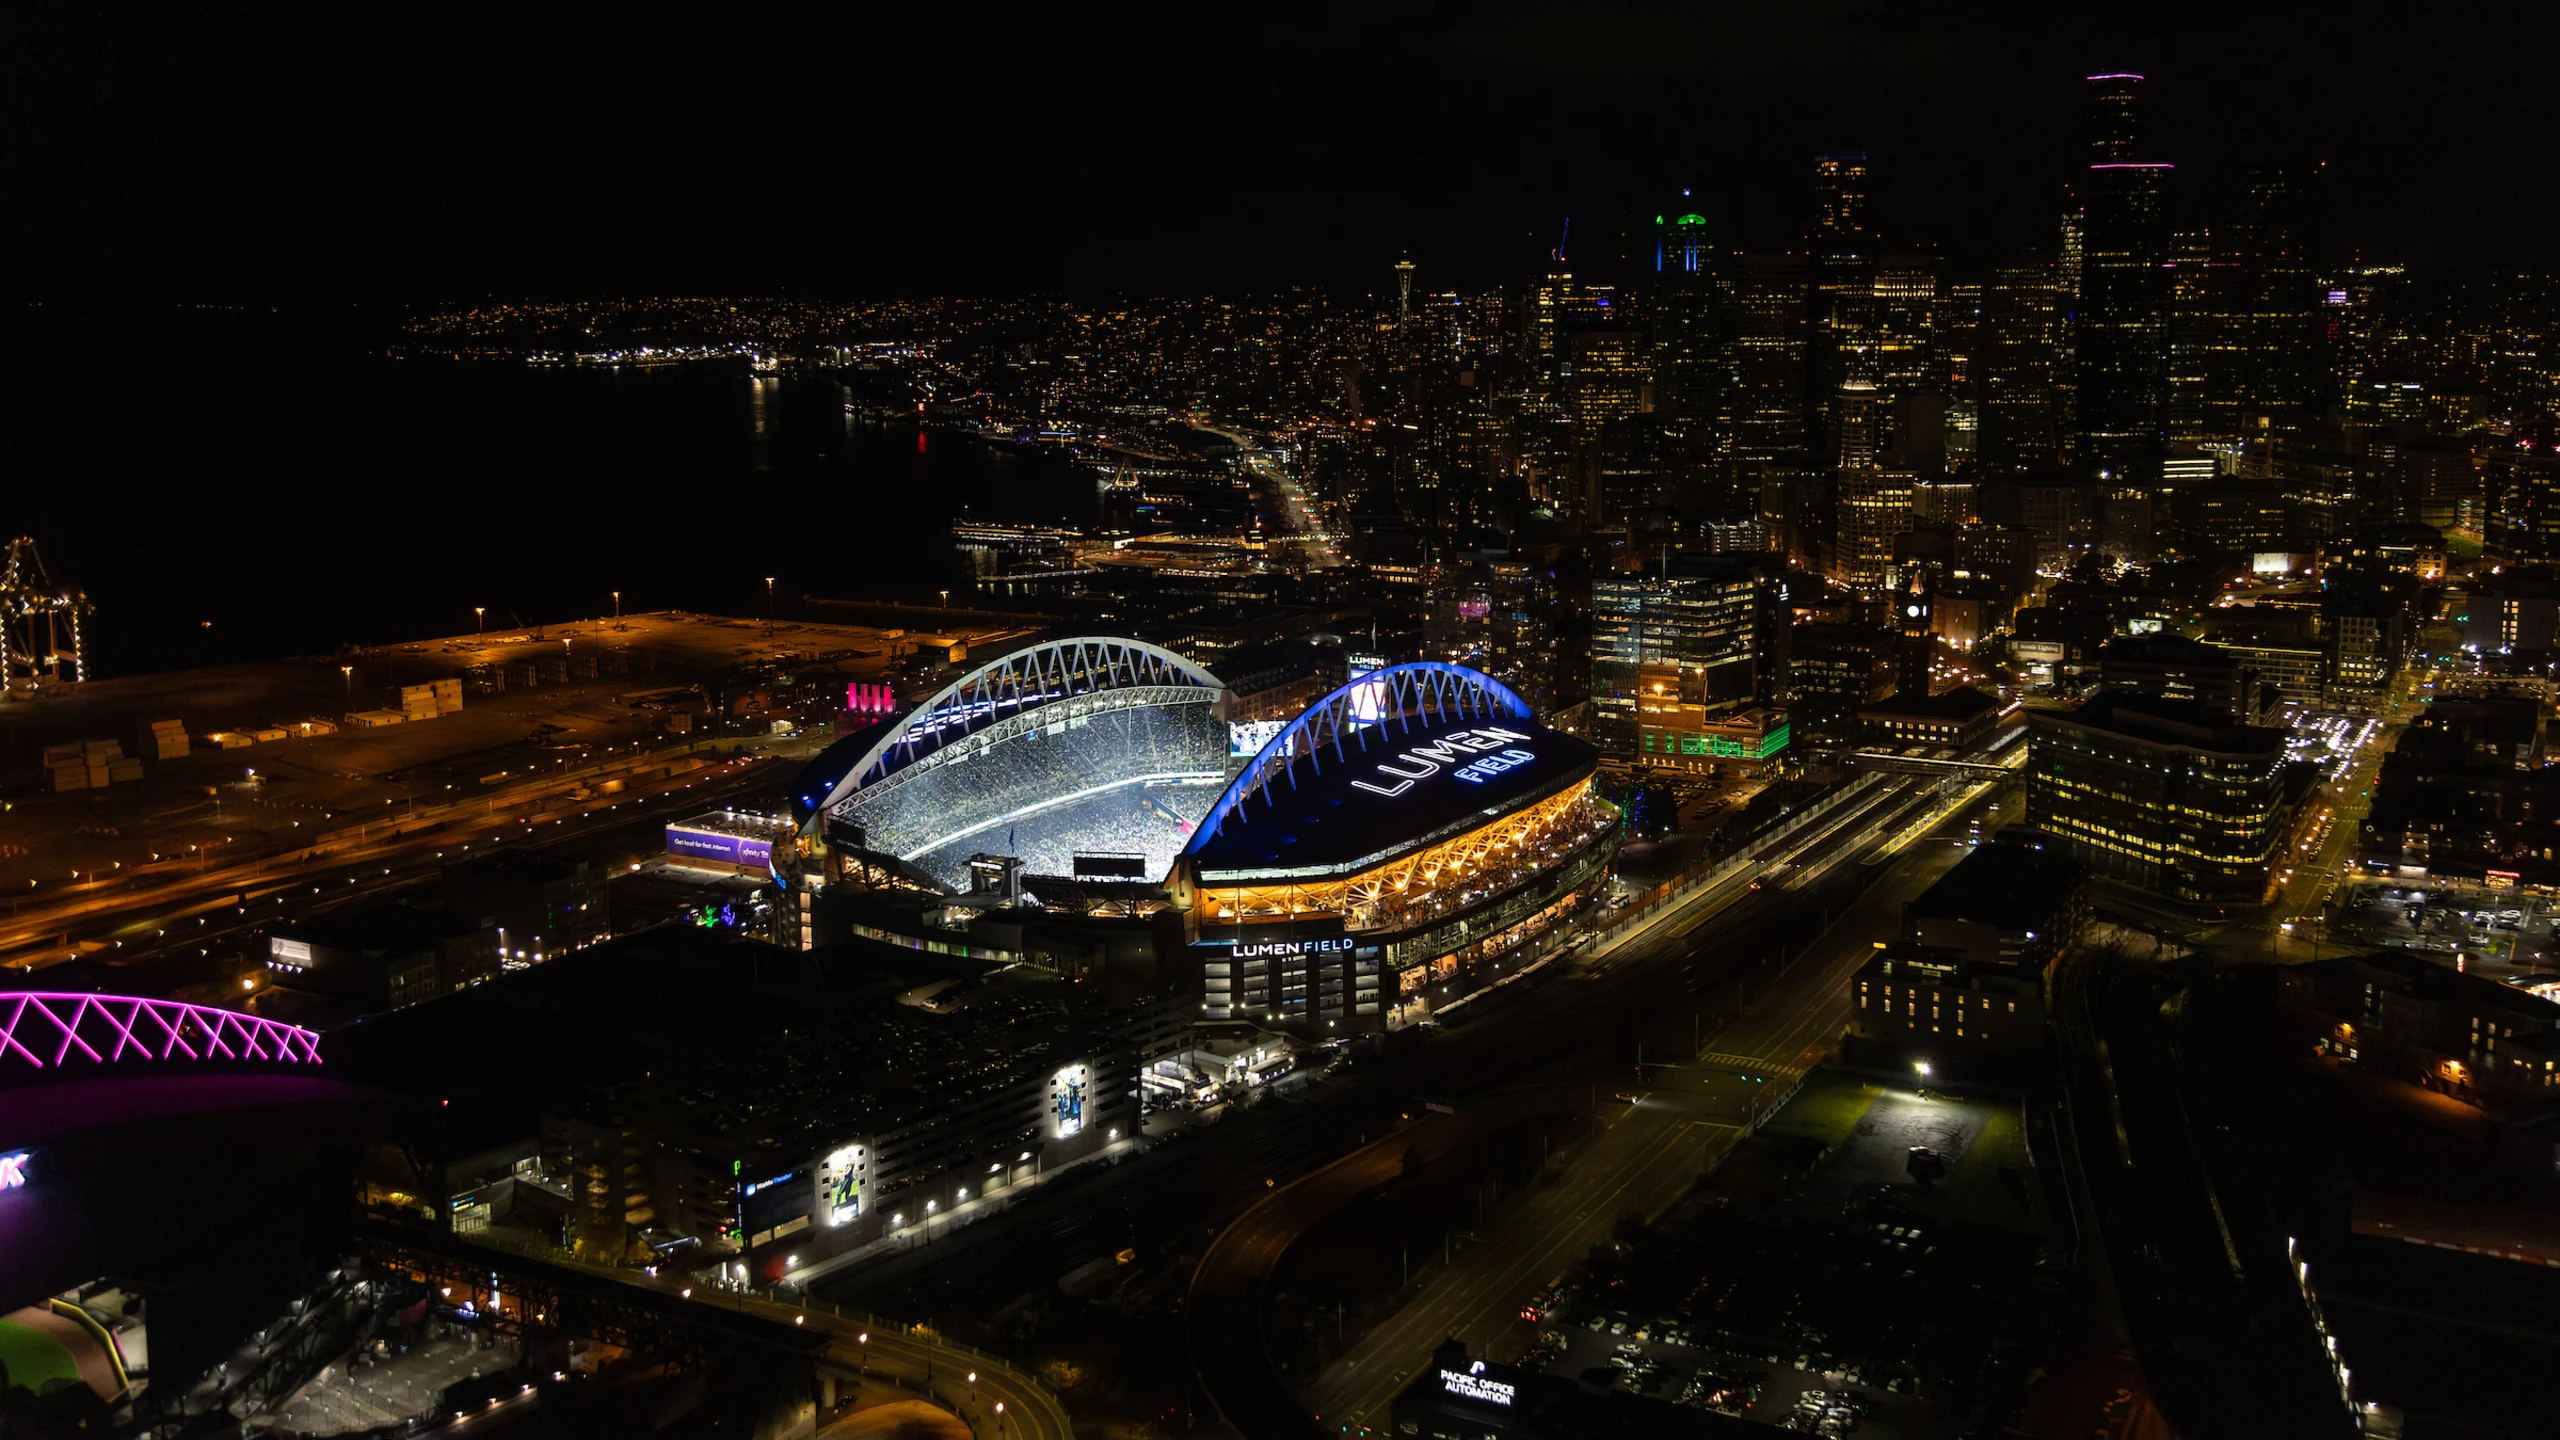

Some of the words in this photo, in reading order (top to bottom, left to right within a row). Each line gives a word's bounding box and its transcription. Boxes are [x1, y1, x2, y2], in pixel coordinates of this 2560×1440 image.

[1349, 656, 1384, 666] LUMEN
[1351, 726, 1532, 797] LUMEN
[1454, 749, 1535, 783] FIELD
[684, 839, 695, 847] loud
[712, 843, 731, 852] internet
[742, 848, 761, 858] xfinity
[1232, 942, 1300, 957] LUMEN
[1304, 938, 1353, 953] FIELD
[1440, 1369, 1477, 1387] PACIFIC
[1479, 1379, 1515, 1396] OFFICE
[1445, 1380, 1511, 1406] AUTOMATION
